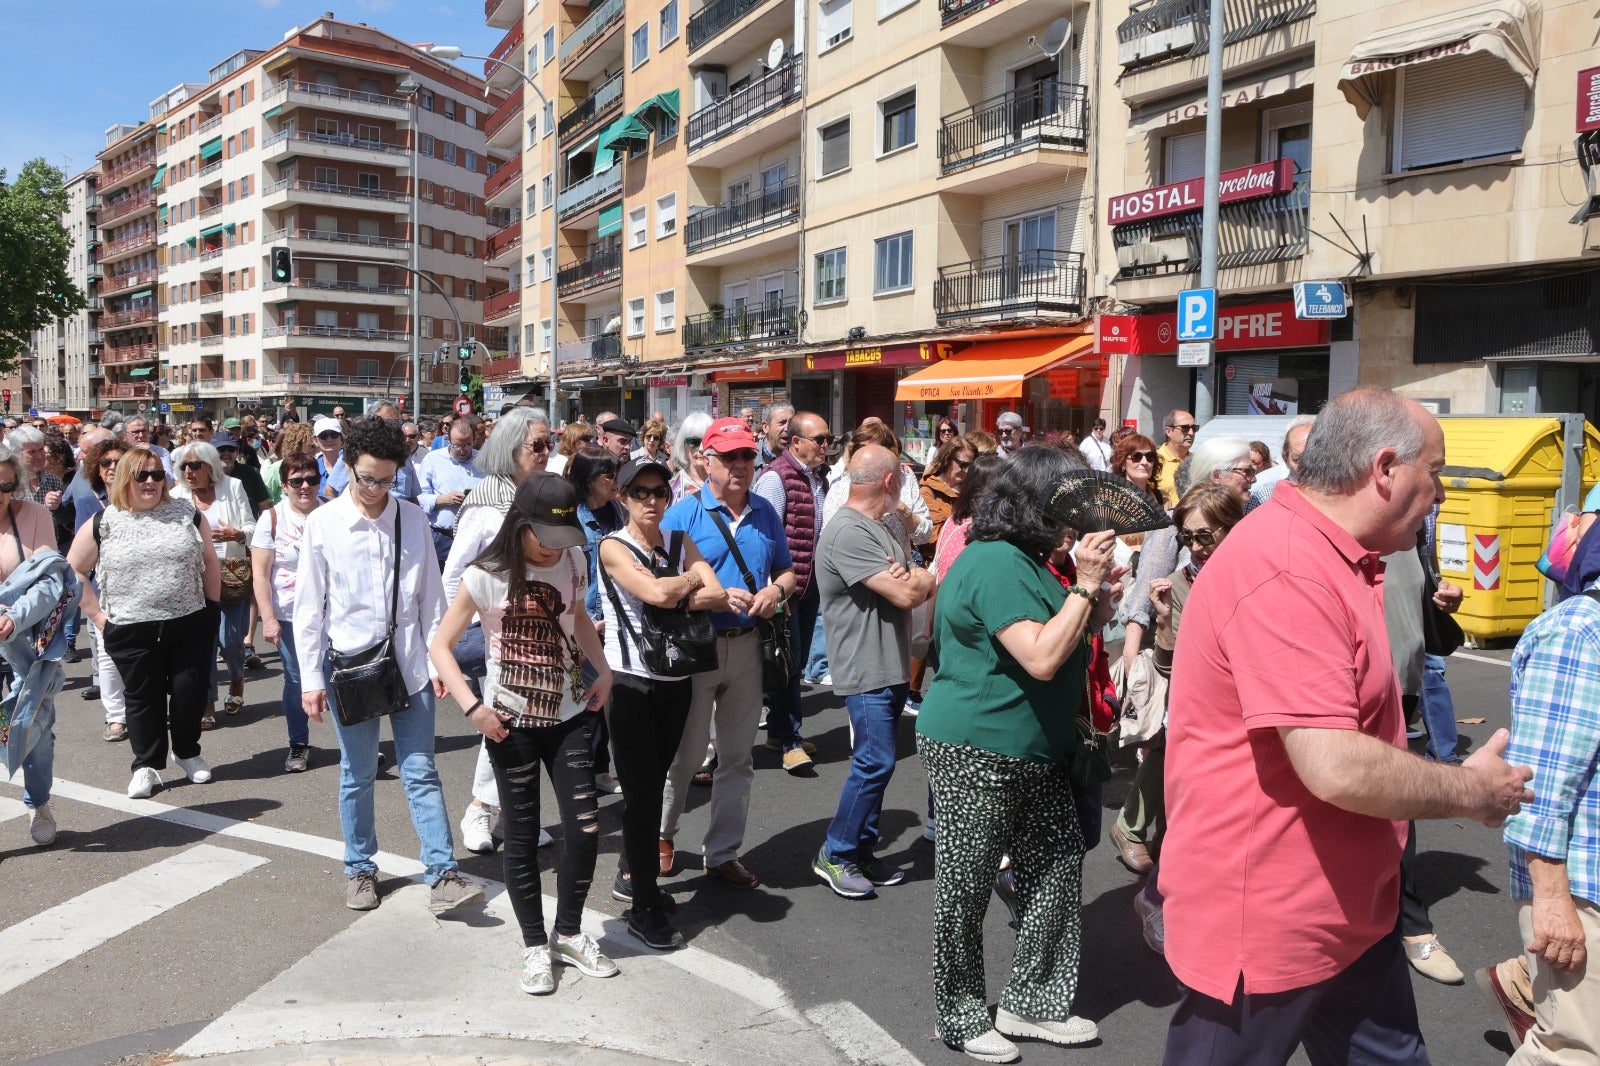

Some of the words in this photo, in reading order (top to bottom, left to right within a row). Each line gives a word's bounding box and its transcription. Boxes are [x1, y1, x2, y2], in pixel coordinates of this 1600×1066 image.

[1350, 39, 1471, 75] BARCELONA
[1111, 185, 1196, 220] HOSTAL
[1218, 169, 1275, 198] rcelona
[1184, 295, 1207, 335] P
[1308, 304, 1343, 315] TELEBANCO
[1218, 312, 1283, 340] PFRE
[845, 349, 882, 362] TABACOS
[985, 384, 994, 395] 26
